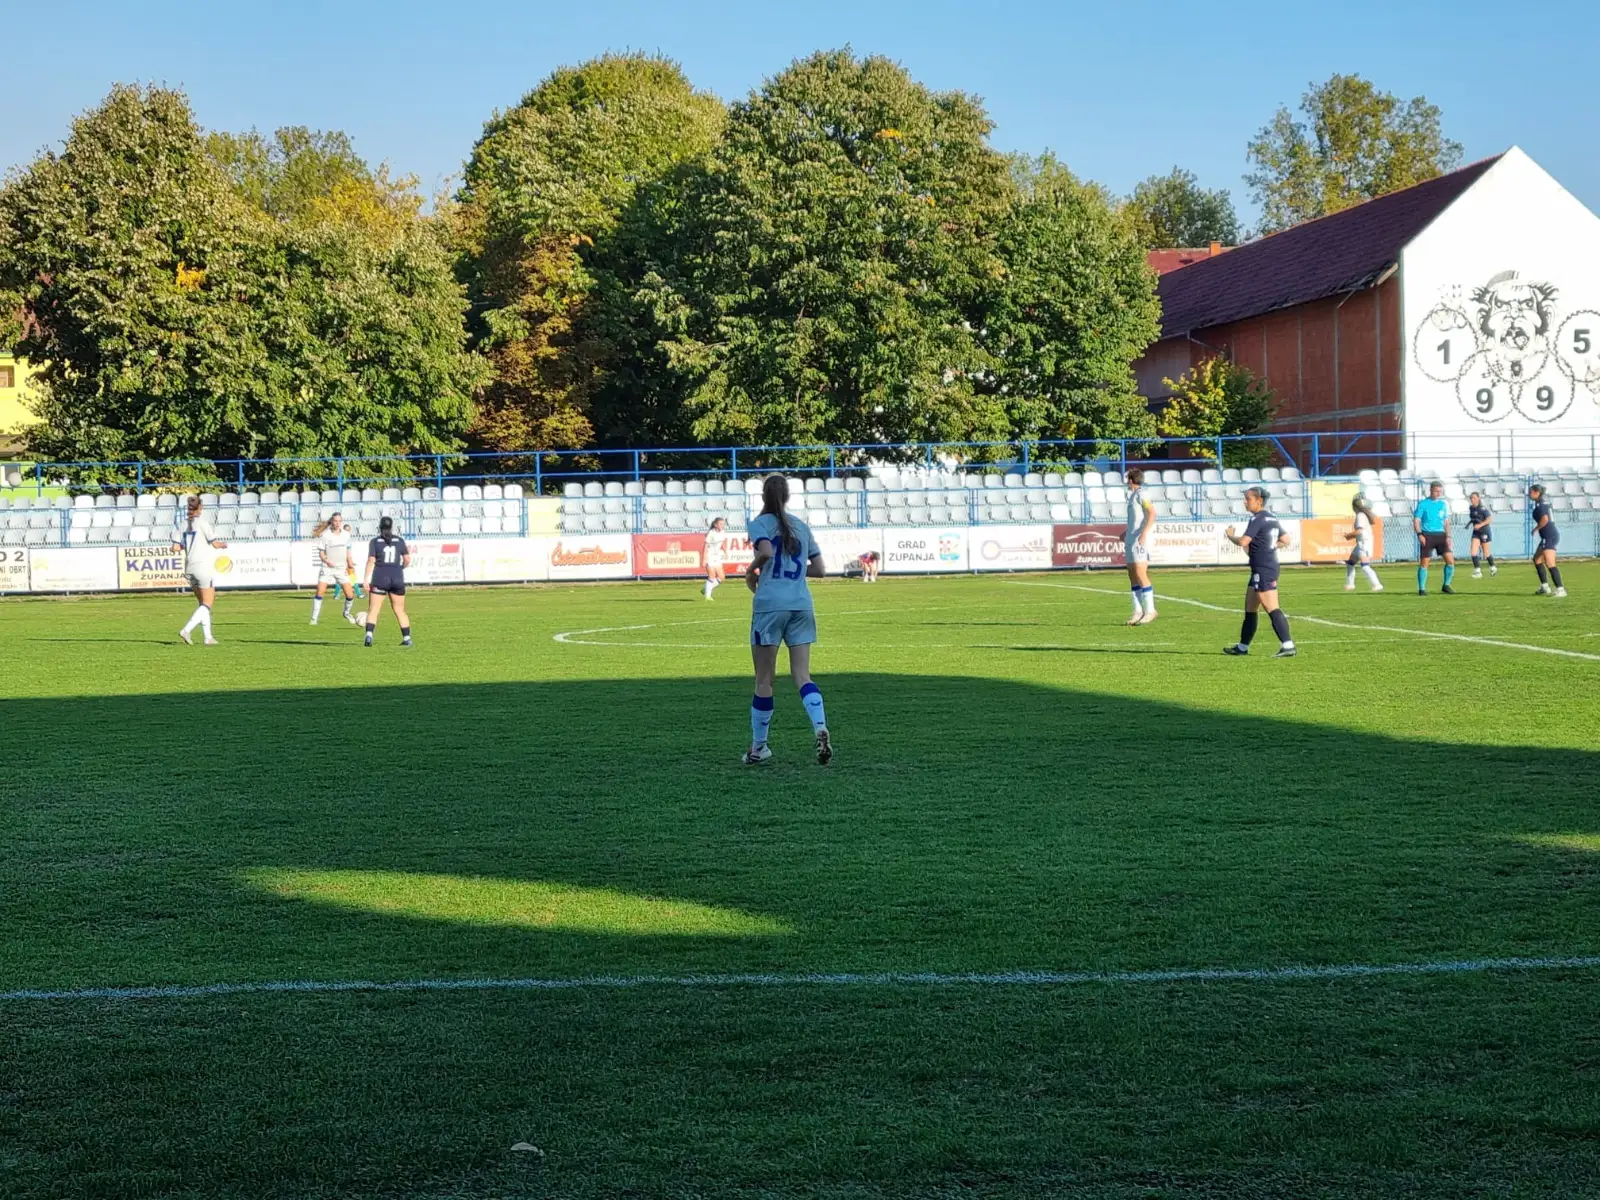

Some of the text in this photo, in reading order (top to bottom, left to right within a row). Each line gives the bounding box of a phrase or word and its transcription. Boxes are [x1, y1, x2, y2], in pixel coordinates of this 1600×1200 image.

[1573, 328, 1591, 354] 5
[1437, 339, 1450, 364] 1
[1476, 388, 1494, 413] 9
[1536, 386, 1554, 411] 9
[1153, 524, 1214, 534] ESARSTVO
[897, 540, 926, 549] GRAD
[1057, 540, 1103, 553] PAVLOVIĆ
[14, 550, 24, 562] 2
[383, 545, 396, 563] 11
[653, 555, 695, 565] Karlovačko
